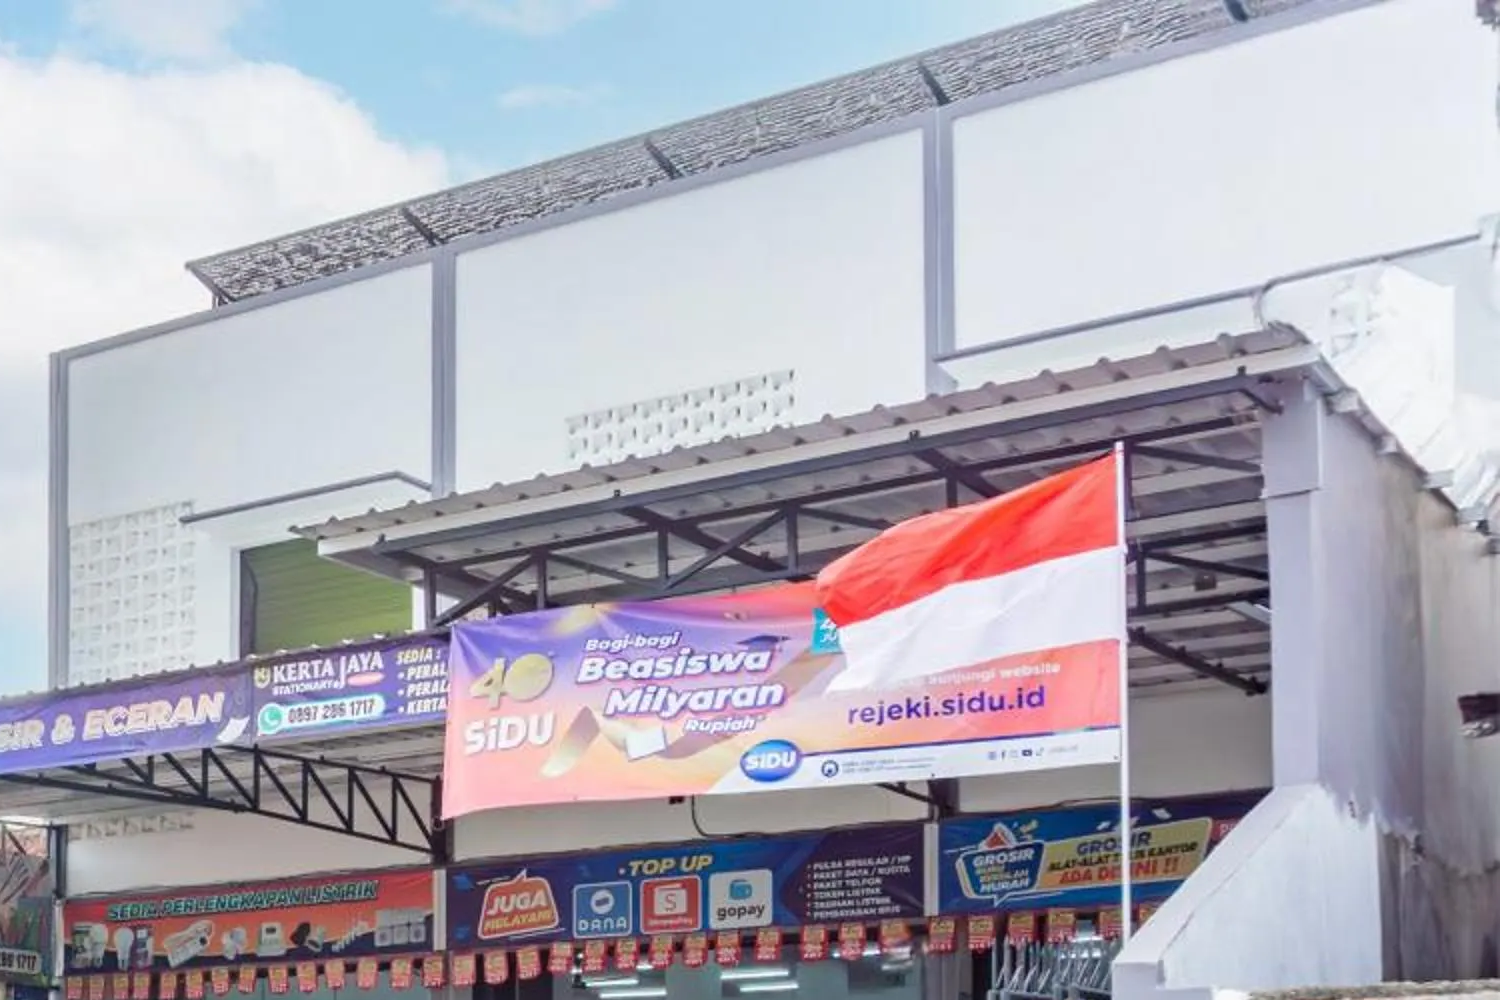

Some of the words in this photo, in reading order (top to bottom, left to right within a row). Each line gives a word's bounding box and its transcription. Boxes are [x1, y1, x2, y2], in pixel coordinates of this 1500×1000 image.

[585, 631, 679, 654] Bagi-bagi
[397, 647, 432, 664] SEDIA
[577, 647, 769, 685] Beasiswa
[273, 658, 334, 682] KERTA
[339, 651, 384, 689] JAYA
[999, 662, 1060, 678] website
[605, 682, 783, 719] Milyaran
[848, 686, 1045, 724] rejeki.sidu.id
[51, 715, 75, 744] &
[83, 692, 225, 740] ECERAN
[462, 711, 554, 755] SiDU
[1077, 832, 1152, 855] GROIR
[628, 858, 678, 876] TOP
[681, 855, 712, 871] UP
[972, 849, 1035, 867] GROSIR
[1059, 868, 1093, 885] ADA
[487, 889, 548, 916] JUGA
[717, 903, 765, 919] gopay
[578, 917, 627, 931] DANA
